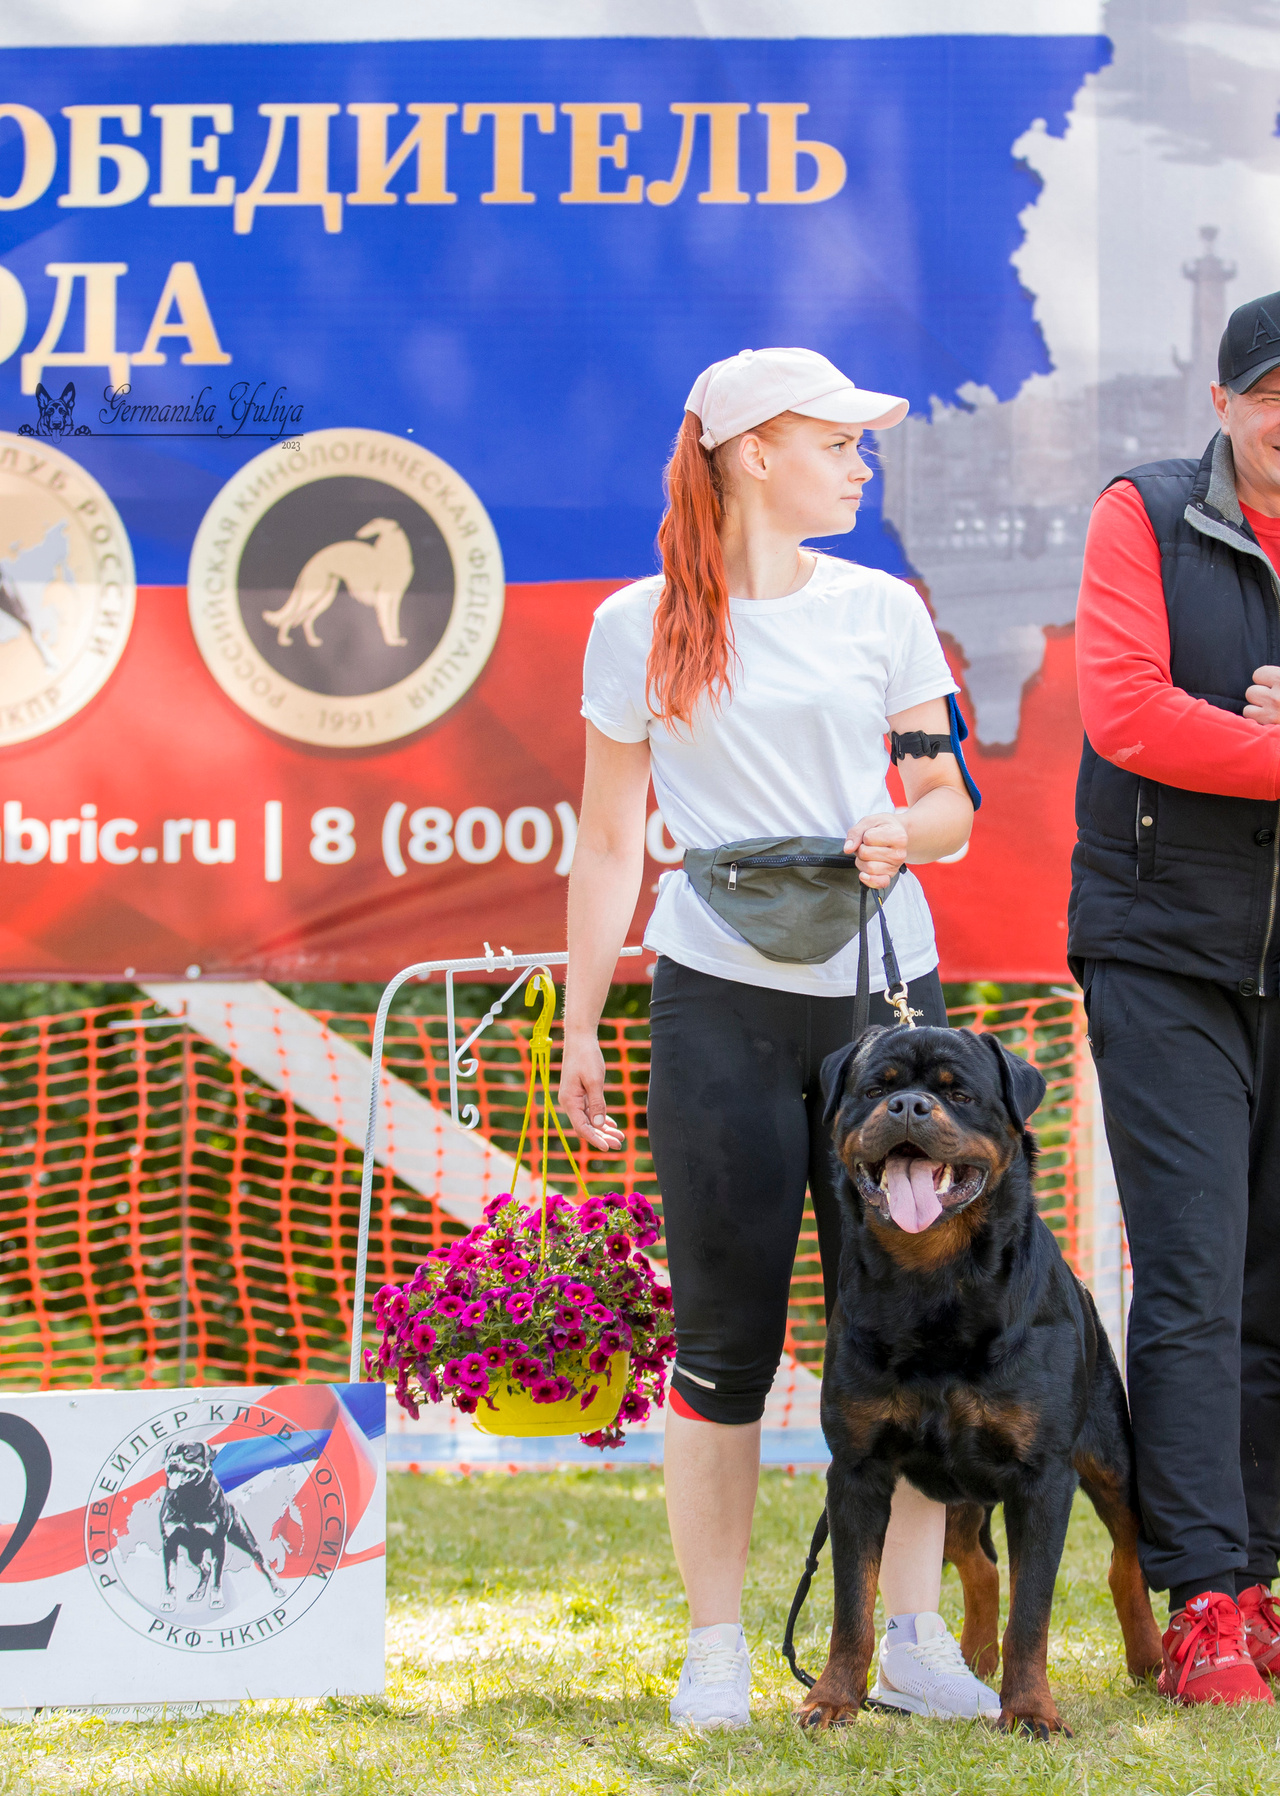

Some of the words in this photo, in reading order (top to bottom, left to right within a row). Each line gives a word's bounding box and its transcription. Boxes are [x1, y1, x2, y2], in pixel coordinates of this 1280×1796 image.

[234, 440, 480, 540] КИНОЛОГИЧЕСКАЯ
[202, 516, 288, 710] РОССИЙСКАЯ
[407, 547, 491, 710] ФЕДЕРАЦИЯ
[318, 708, 376, 732] 1991
[0, 800, 236, 865] bric.ru
[309, 806, 357, 865] 8
[382, 800, 580, 877] (800)
[89, 1409, 189, 1590] РОТВЕЙЛЕР
[209, 1403, 296, 1442] КЛУБ
[302, 1447, 343, 1582] РОССИИ
[147, 1607, 288, 1649] РКФ-НКПР
